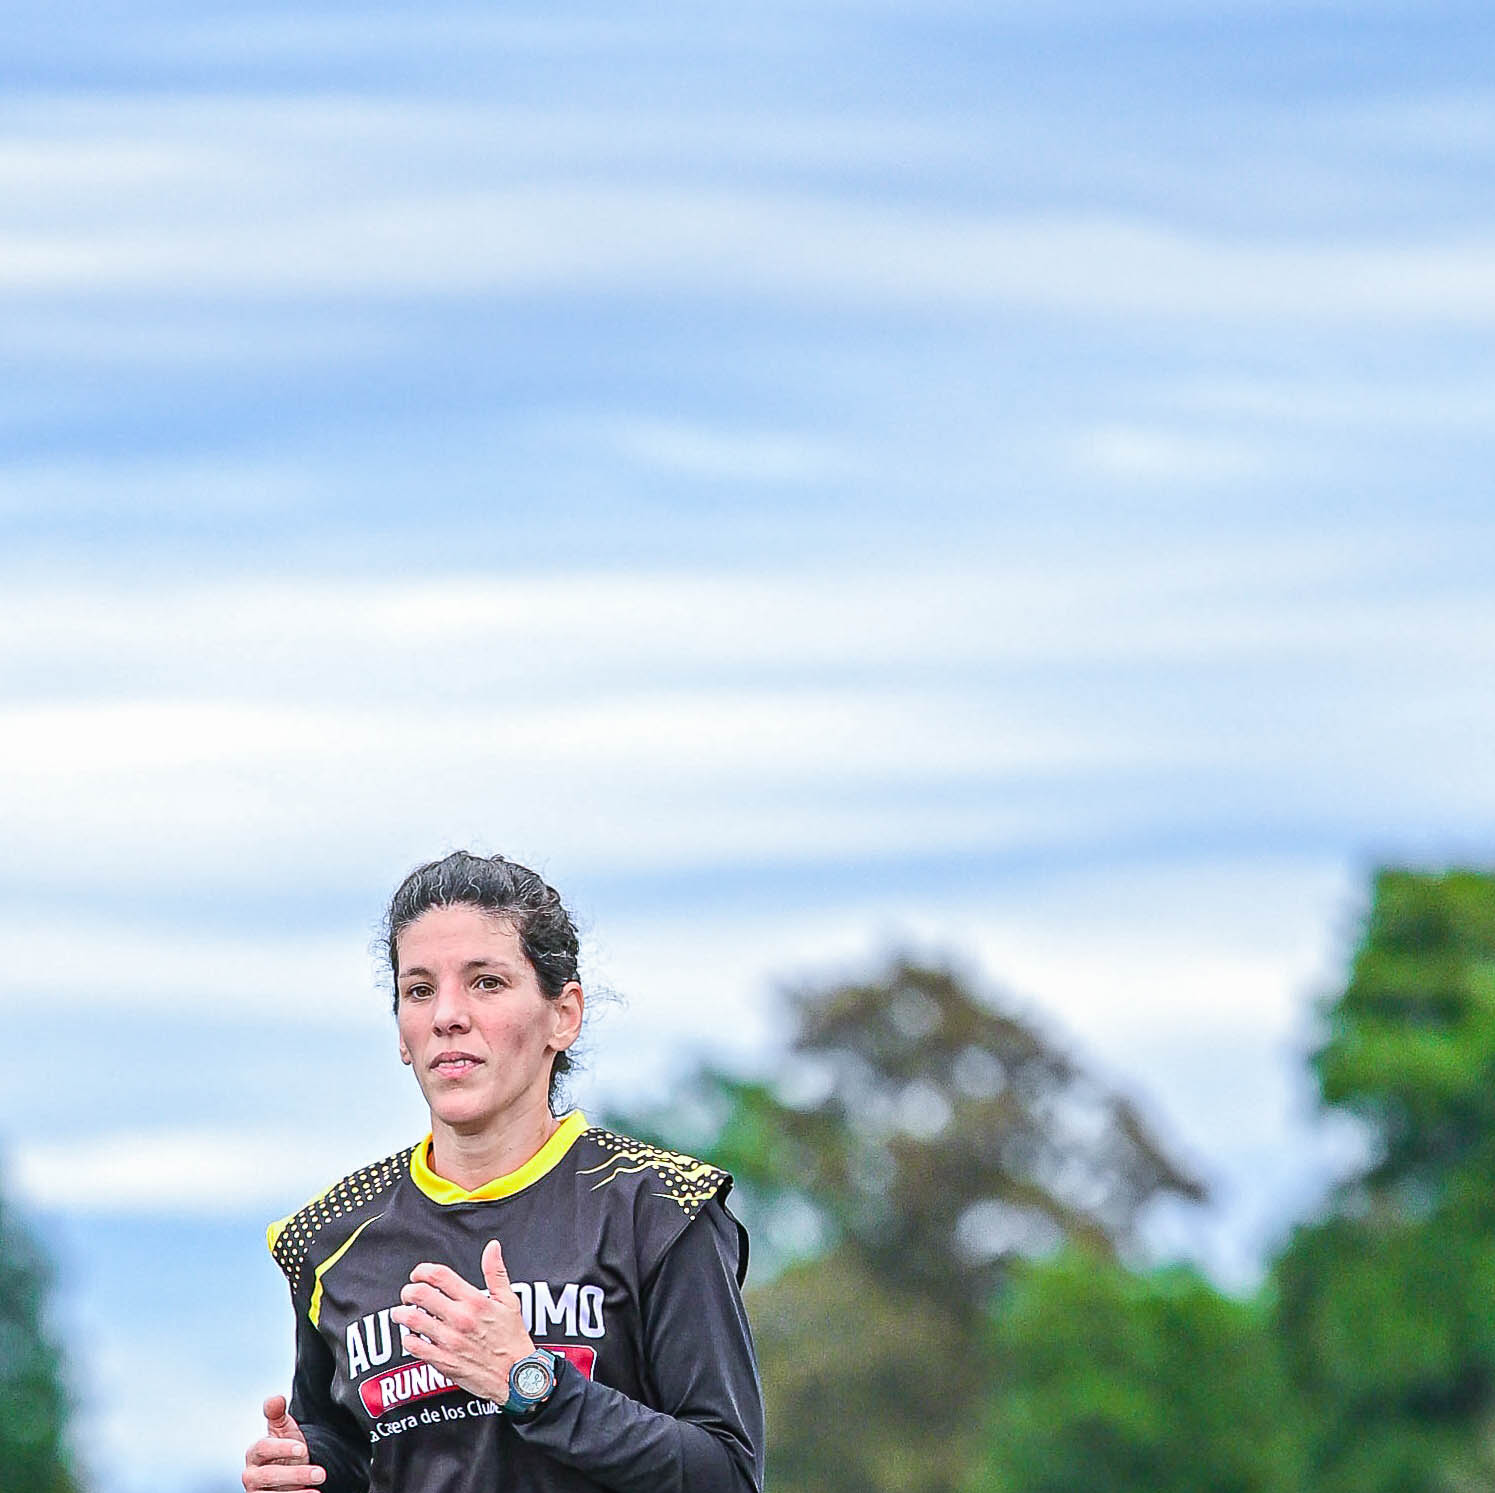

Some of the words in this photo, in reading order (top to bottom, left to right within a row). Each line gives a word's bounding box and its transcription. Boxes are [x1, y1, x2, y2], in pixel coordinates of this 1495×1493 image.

[379, 1364, 454, 1408] RUNN
[420, 1408, 441, 1424] de
[441, 1405, 466, 1421] los
